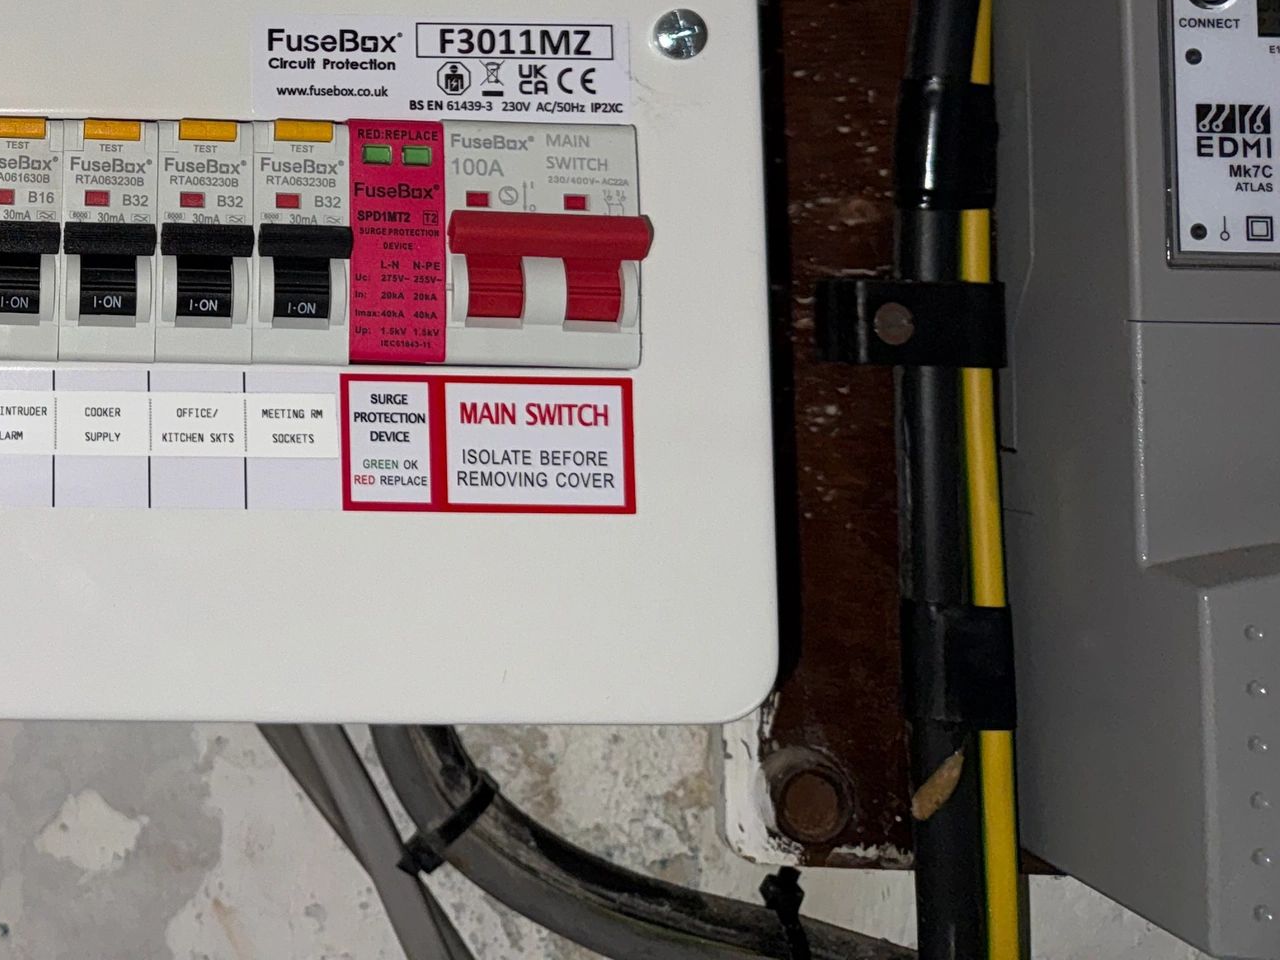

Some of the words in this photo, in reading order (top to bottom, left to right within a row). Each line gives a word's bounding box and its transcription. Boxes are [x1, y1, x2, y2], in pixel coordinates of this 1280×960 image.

[1179, 18, 1241, 29] CONNECT
[439, 28, 592, 55] F3011MZ
[268, 57, 316, 69] Circuit
[322, 58, 396, 70] Protection
[276, 85, 389, 97] www.fusebox.co.uk
[409, 100, 424, 110] BS
[427, 100, 443, 111] EN
[447, 100, 493, 111] 61439-3
[502, 101, 531, 112] 230V
[536, 102, 585, 114] AC/50Hz
[590, 102, 624, 113] IP2XC
[6, 141, 30, 150] TEST
[546, 134, 591, 148] MAIN
[100, 144, 123, 152] TEST
[194, 145, 218, 153] TEST
[291, 145, 314, 153] TEST
[1196, 136, 1272, 159] EDMI
[452, 158, 505, 177] 100A
[546, 156, 608, 172] SWITCH
[1229, 164, 1273, 179] Mk7C
[75, 174, 145, 187] RTA063230B
[170, 175, 239, 188] RTA063230B
[266, 175, 337, 188] RTA063230B
[1235, 182, 1273, 192] ATLAS
[28, 192, 55, 204] B16
[122, 194, 149, 207] B32
[217, 195, 244, 207] B32
[315, 196, 342, 208] B32
[3, 209, 32, 220] 30mA
[97, 212, 125, 223] 30mA
[192, 214, 220, 224] 30mA
[289, 214, 318, 224] 30mA
[360, 227, 386, 235] SURGE
[388, 228, 439, 237] PROTECTION
[383, 242, 413, 250] DEVICE
[370, 393, 408, 405] SURGE
[84, 407, 121, 417] COOKER
[176, 408, 218, 418] OFFICE/
[261, 409, 305, 419] MEETING
[310, 409, 323, 419] RM
[353, 412, 426, 424] PROTECTION
[460, 402, 516, 425] MAIN
[525, 403, 609, 426] SWITCH
[84, 432, 121, 442] SUPPLY
[161, 432, 204, 443] KITCHEN
[210, 433, 235, 443] SKTS
[272, 433, 315, 444] SOCKETS
[370, 431, 410, 442] DEVICE
[462, 449, 531, 466] ISOLATE
[540, 449, 608, 467] BEFORE
[362, 459, 399, 470] GREEN
[403, 459, 418, 470] OK
[354, 474, 376, 485] RED
[380, 475, 428, 487] REPLACE
[457, 471, 548, 488] REMOVING
[555, 471, 615, 489] COVER
